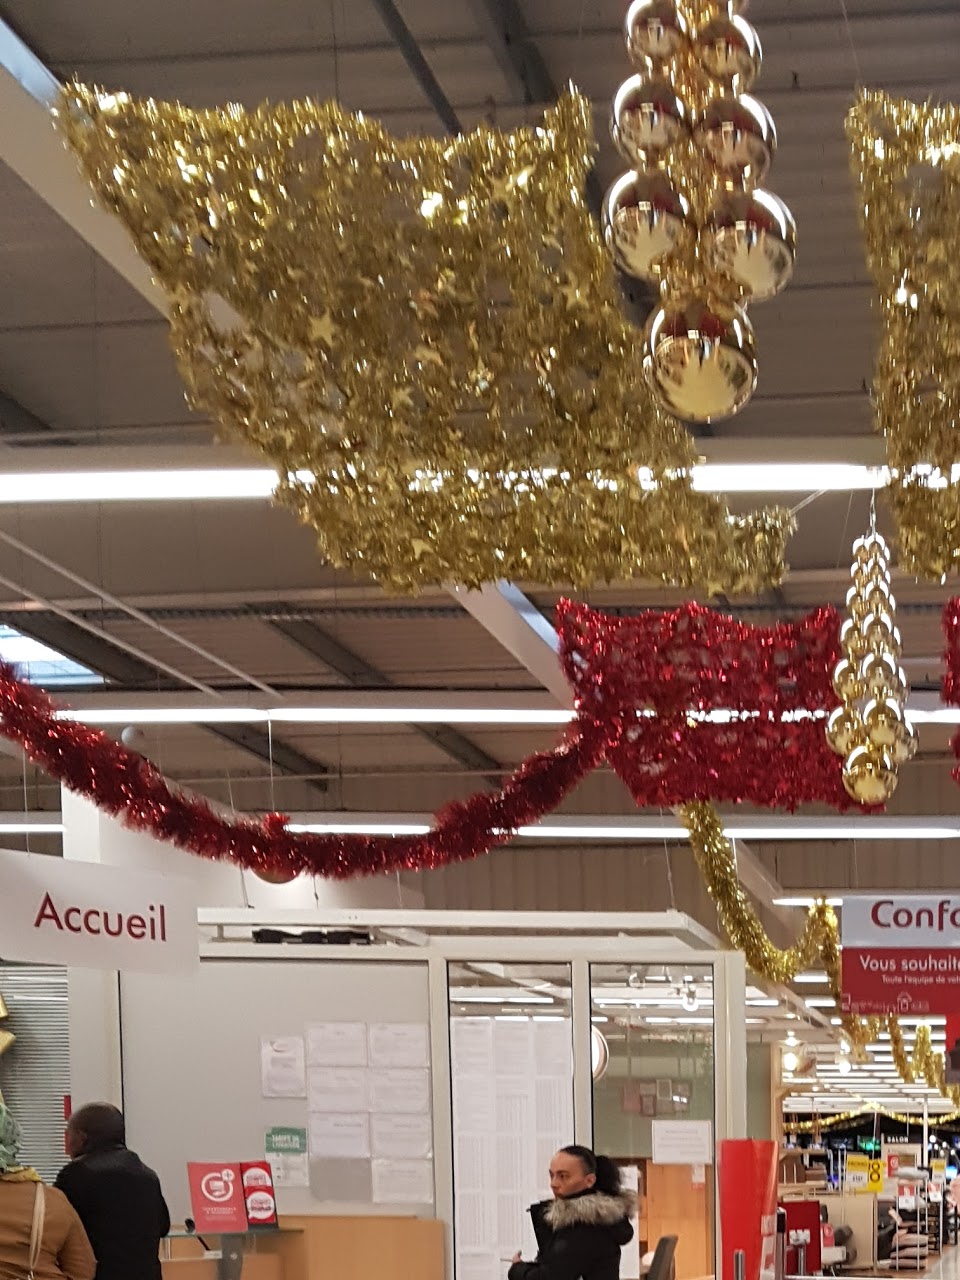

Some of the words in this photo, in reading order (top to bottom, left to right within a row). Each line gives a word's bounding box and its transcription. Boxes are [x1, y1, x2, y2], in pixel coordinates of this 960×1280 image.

[33, 892, 167, 942] Accueil
[860, 955, 896, 971] Vous
[882, 974, 902, 984] Toute
[936, 974, 946, 984] de
